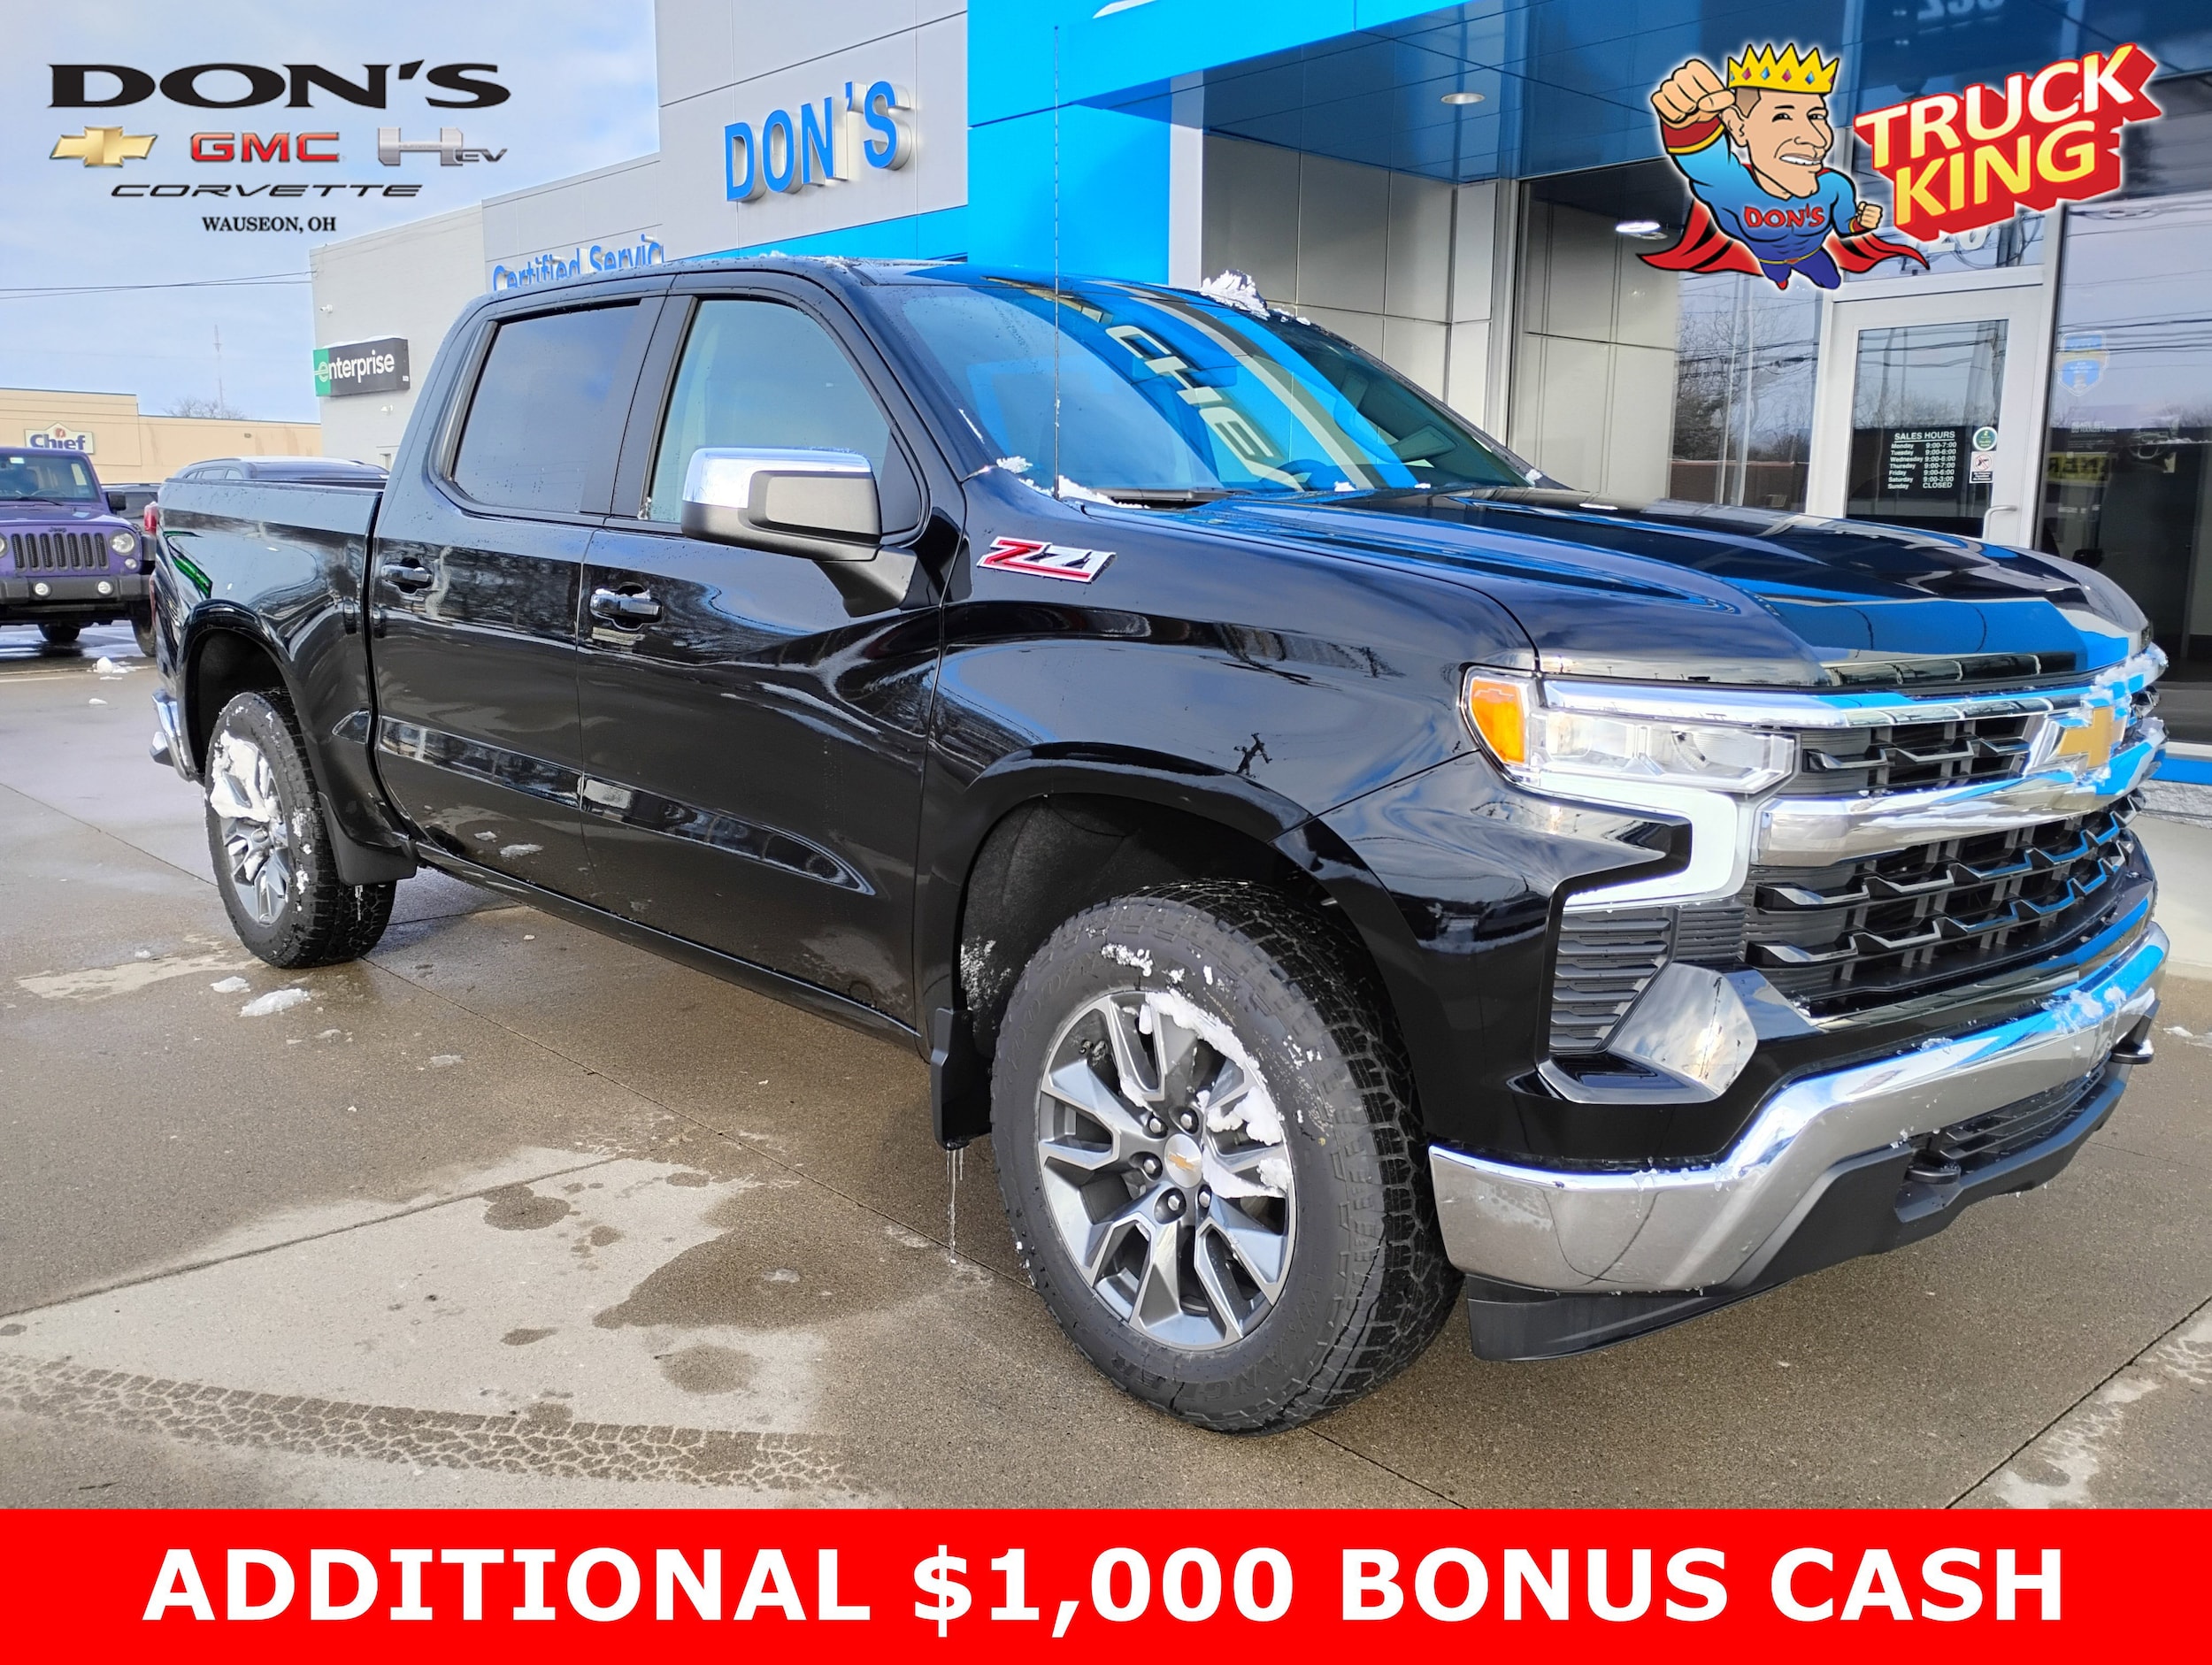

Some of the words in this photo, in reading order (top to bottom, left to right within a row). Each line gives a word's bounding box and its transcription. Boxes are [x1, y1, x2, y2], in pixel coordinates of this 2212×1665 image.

[725, 81, 897, 201] DON'S
[590, 234, 664, 272] Servic
[318, 349, 395, 383] enterprise
[29, 434, 86, 450] Chief
[977, 535, 1117, 584] Z71
